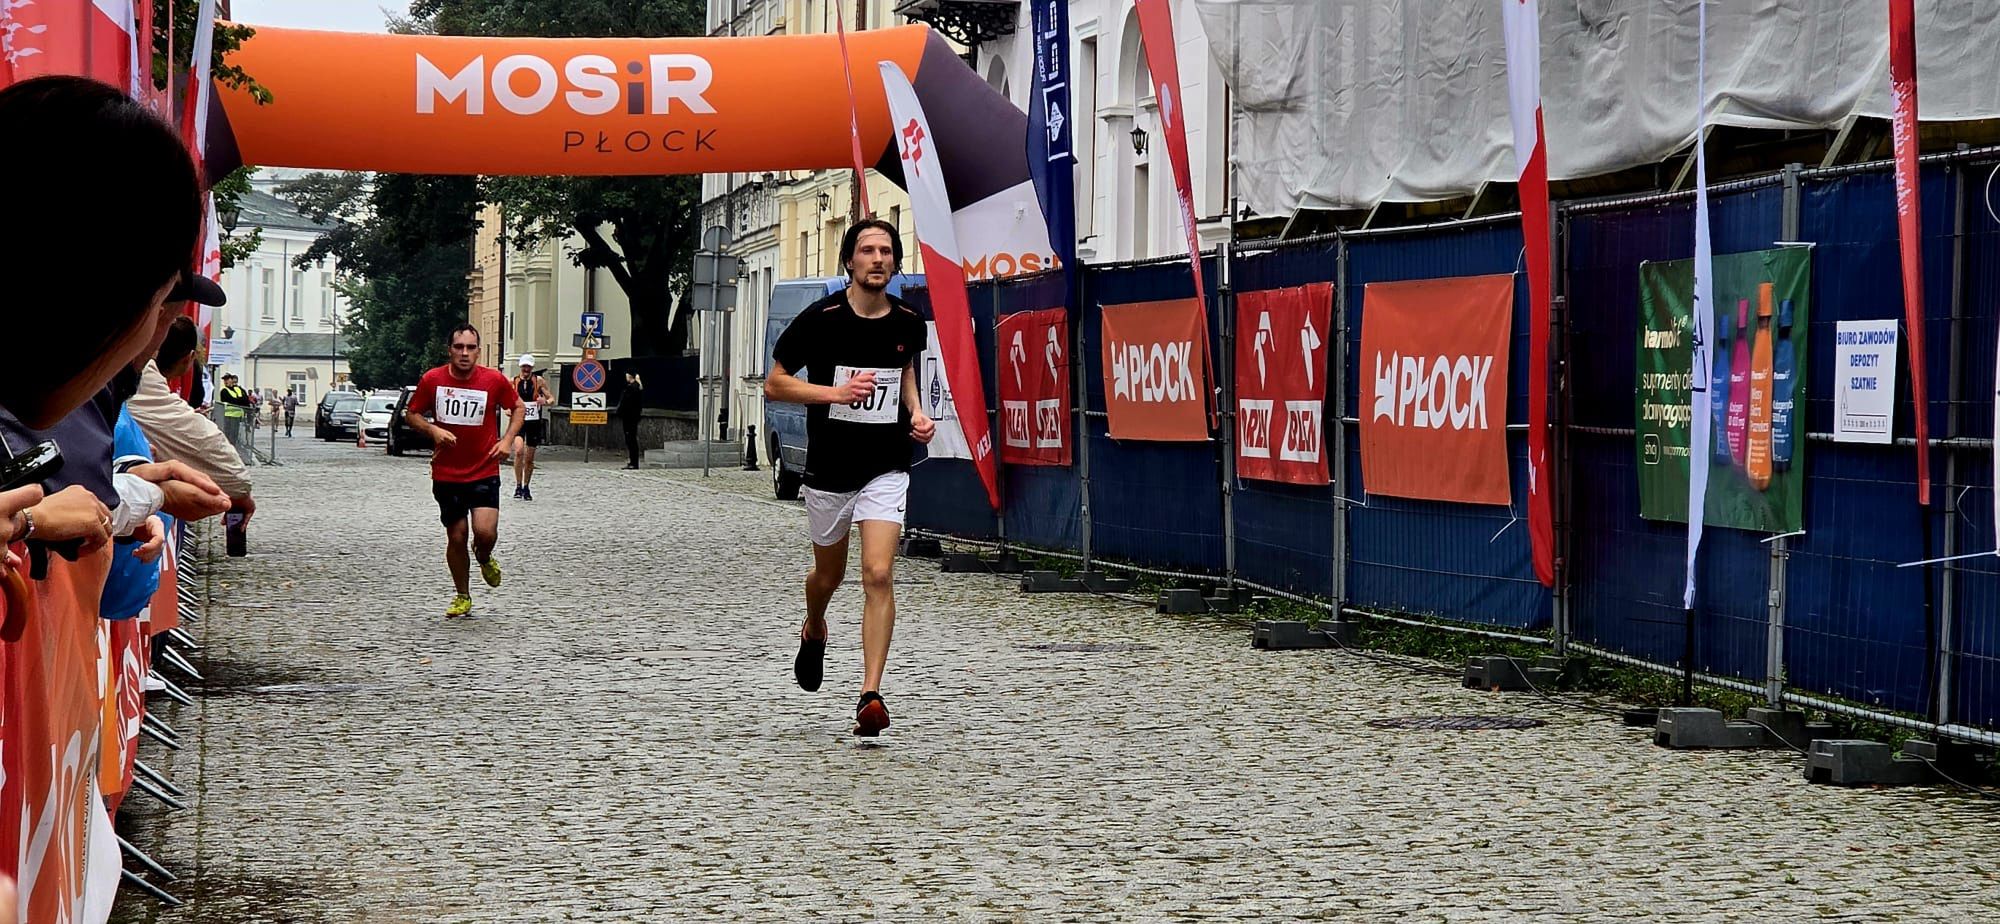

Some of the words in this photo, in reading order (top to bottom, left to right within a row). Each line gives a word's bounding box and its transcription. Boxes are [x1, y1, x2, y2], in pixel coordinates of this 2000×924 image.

[415, 52, 718, 116] MOSiR
[563, 128, 718, 153] PŁOCK
[963, 252, 1063, 283] MOS
[1838, 331, 1857, 345] BIURO
[1859, 328, 1896, 345] ZAWODÓW
[1129, 341, 1196, 403] PŁOCK
[1850, 354, 1879, 368] DEPOZYT
[1398, 354, 1494, 431] PŁOCK
[1851, 377, 1877, 390] SZATNIE
[445, 399, 479, 418] 1017
